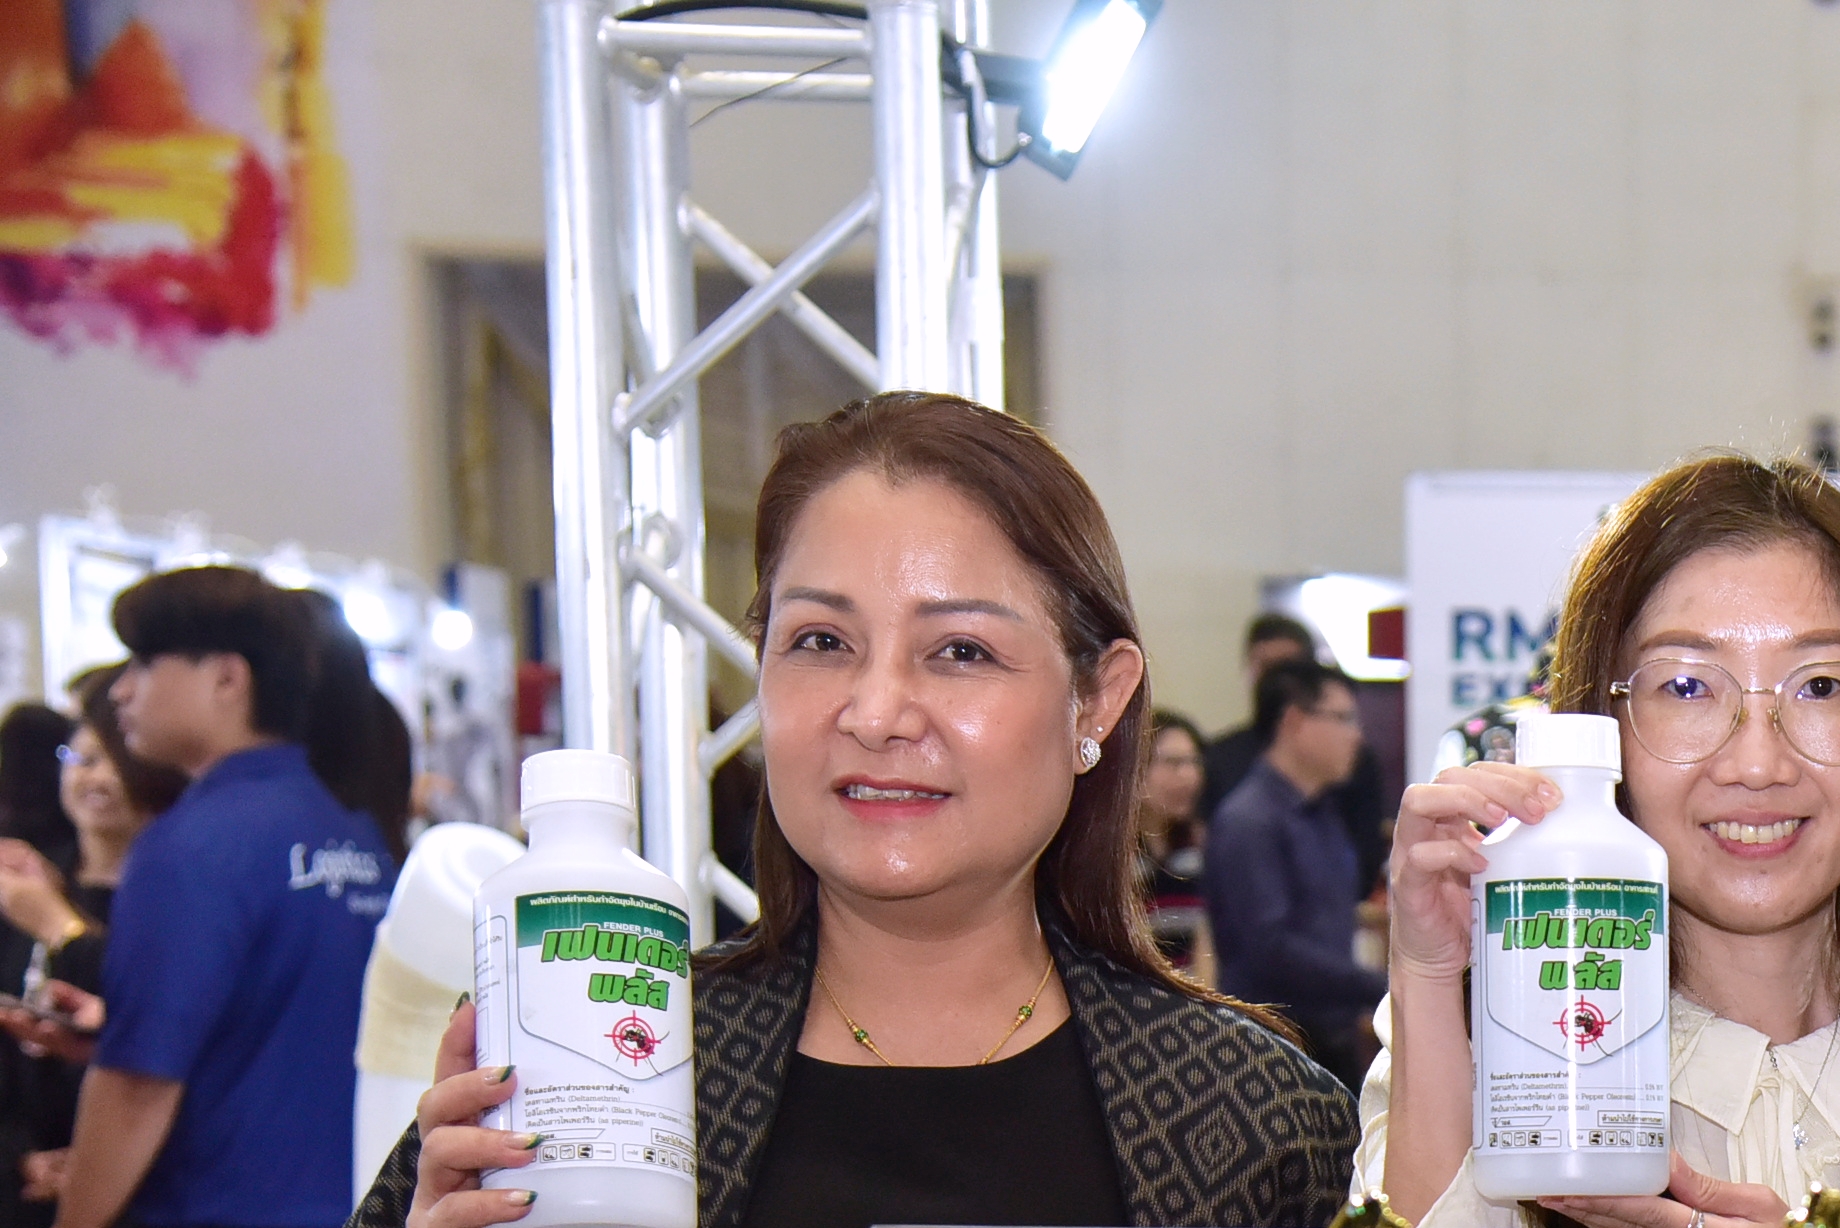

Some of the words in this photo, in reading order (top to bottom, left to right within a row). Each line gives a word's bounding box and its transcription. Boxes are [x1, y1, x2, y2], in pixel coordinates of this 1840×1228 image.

[1554, 908, 1592, 917] FENDER
[1594, 908, 1618, 917] PLUS
[603, 921, 642, 934] FENDER
[643, 926, 664, 938] PLUS
[1502, 909, 1656, 951] เฟนเดอร์
[540, 923, 689, 979] เฟนเดอร์
[1538, 951, 1624, 991] พลัส
[587, 967, 670, 1011] พลัส
[1581, 1093, 1604, 1101] Pepper
[611, 1106, 632, 1115] (Black
[635, 1108, 657, 1118] Pepper
